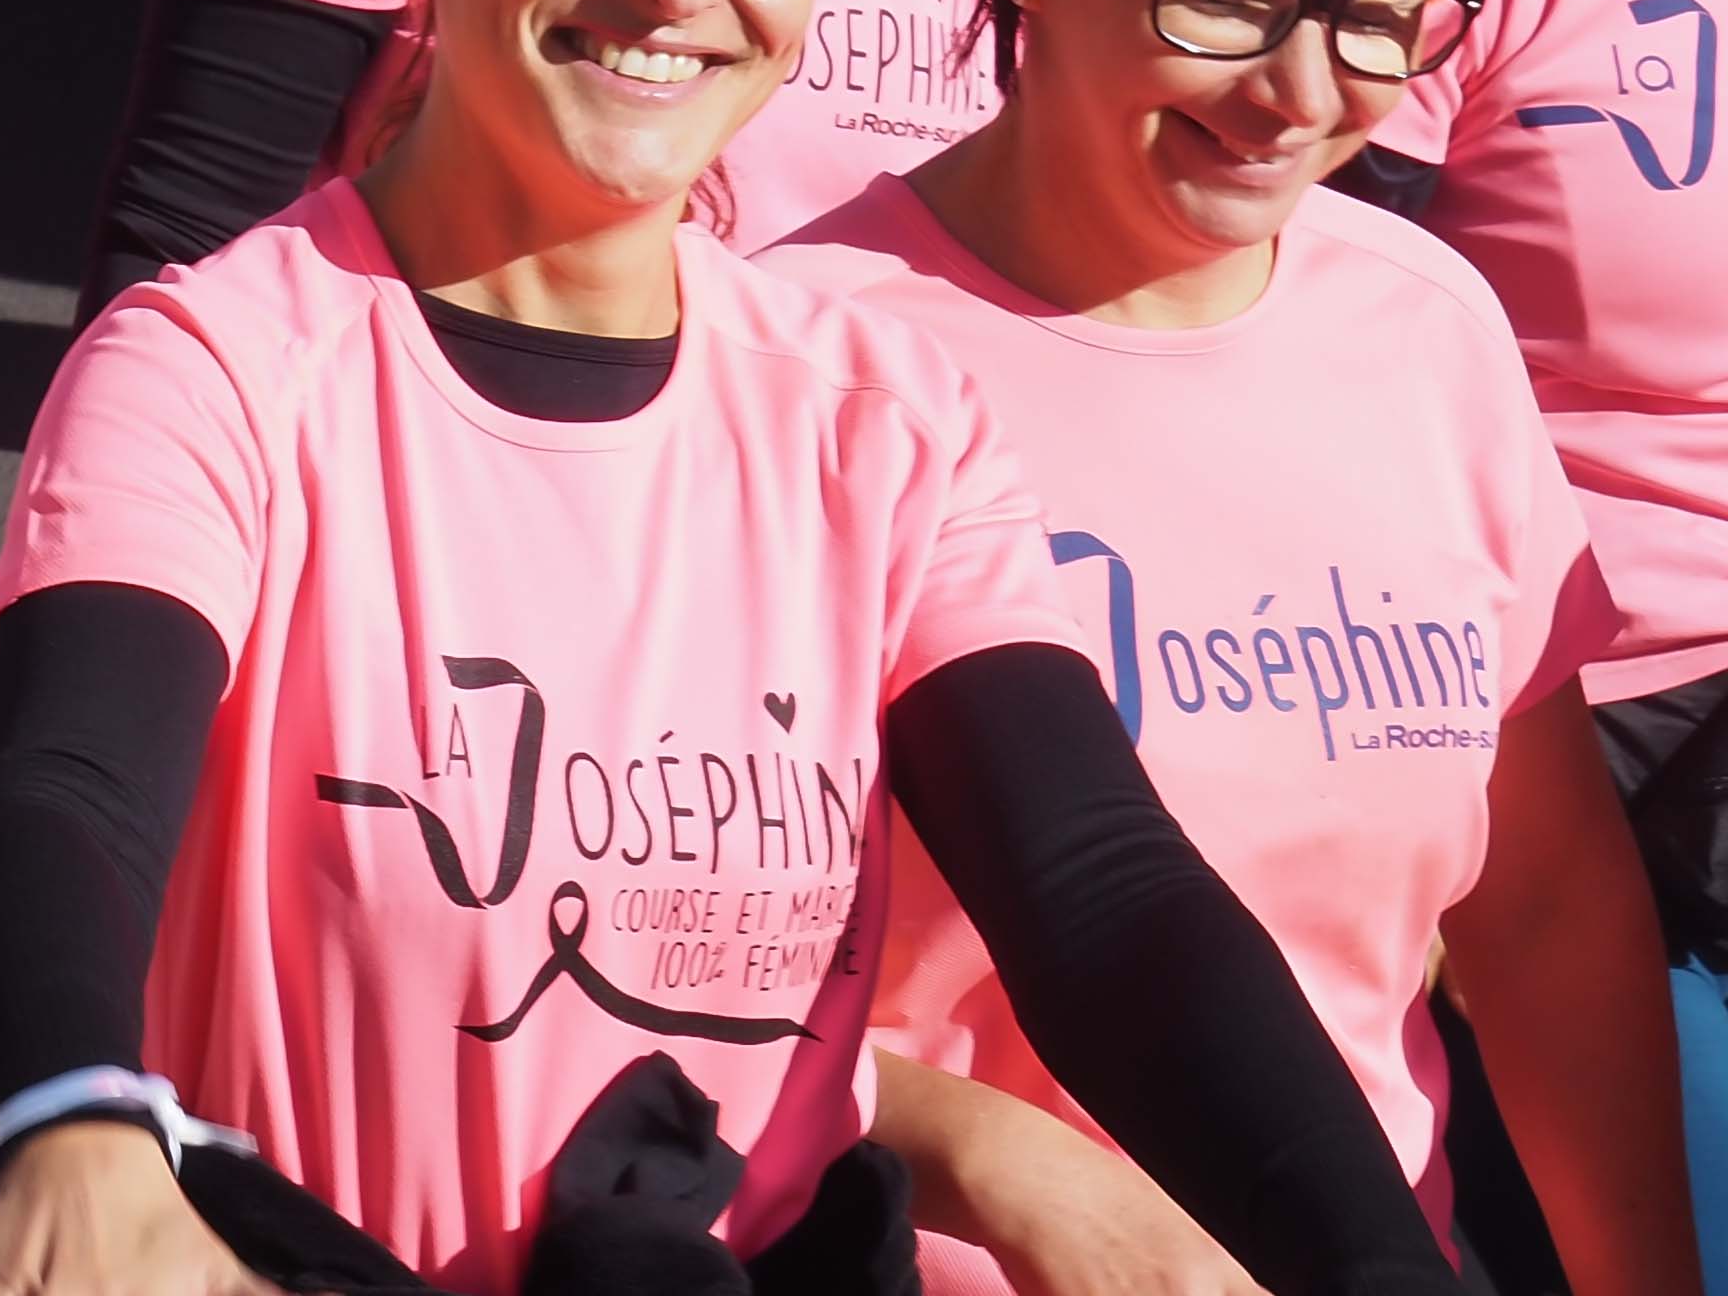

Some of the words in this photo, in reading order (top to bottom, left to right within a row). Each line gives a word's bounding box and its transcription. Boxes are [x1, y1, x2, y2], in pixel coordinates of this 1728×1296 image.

[1611, 42, 1676, 96] la
[419, 702, 472, 780] LA
[1351, 731, 1381, 750] La
[315, 654, 866, 910] JOSÉPHIN
[610, 889, 721, 933] COURSE
[735, 890, 774, 934] ET
[649, 940, 728, 989] 100%
